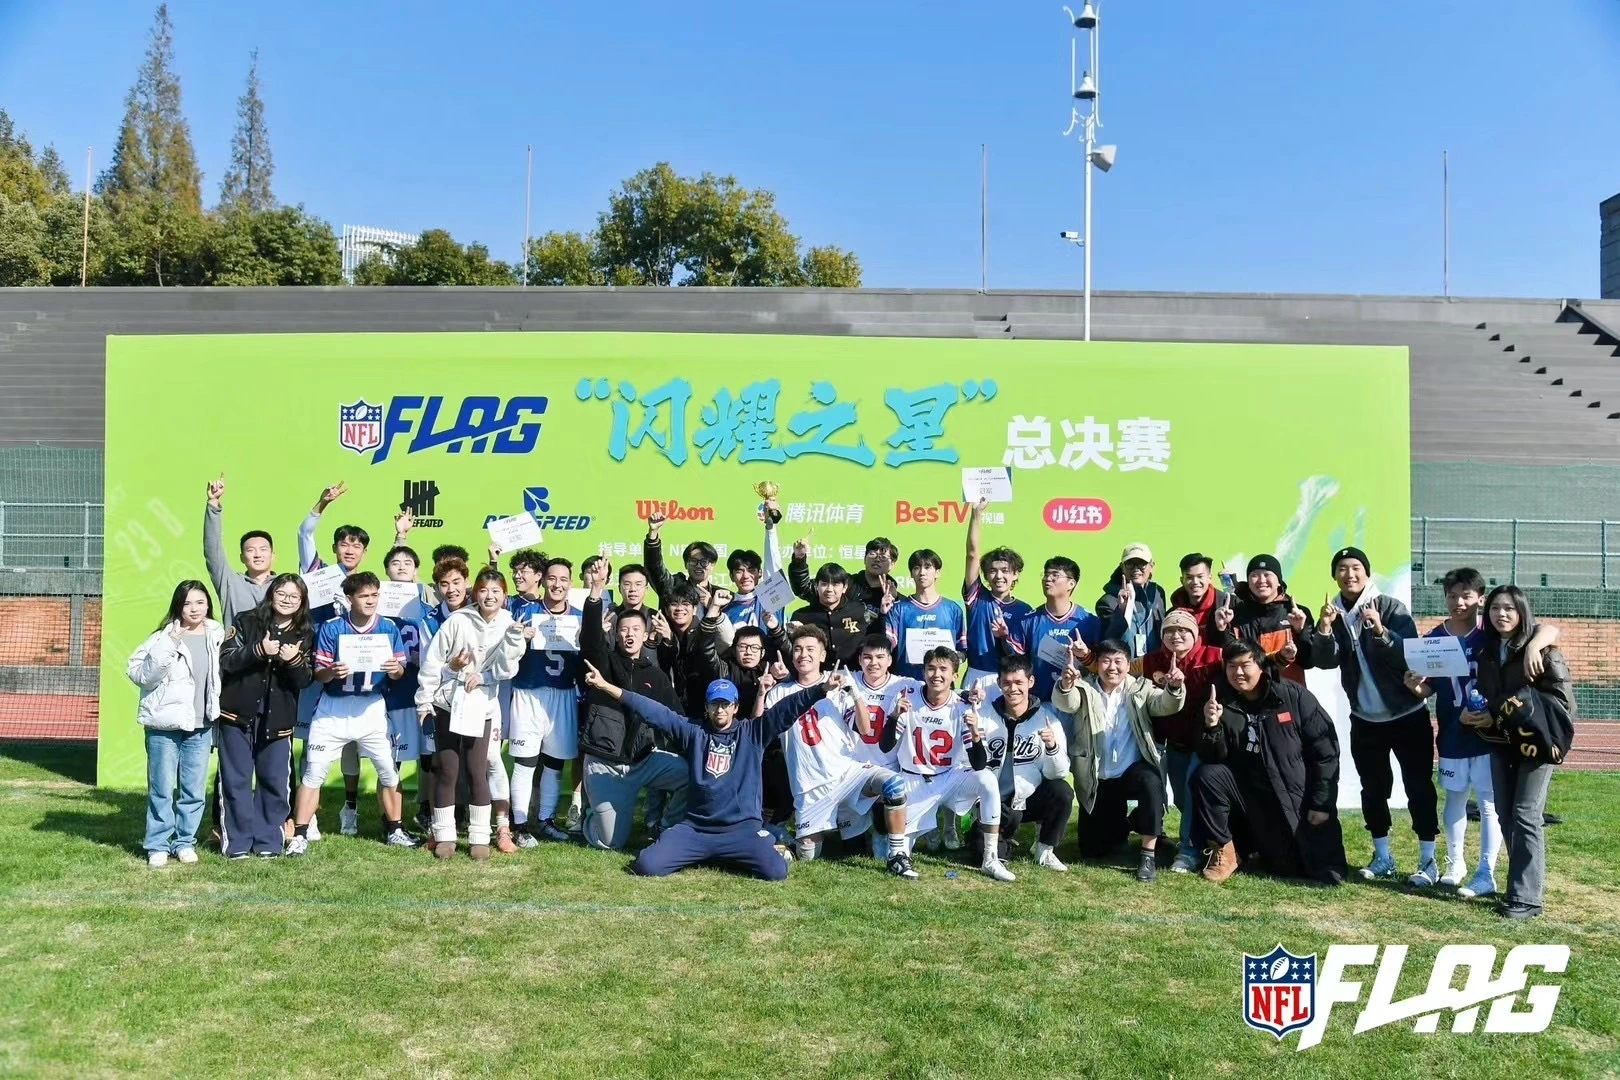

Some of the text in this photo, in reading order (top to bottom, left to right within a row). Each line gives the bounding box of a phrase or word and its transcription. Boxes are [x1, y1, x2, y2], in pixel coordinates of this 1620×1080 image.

[344, 396, 549, 465] NFL FLAG
[1002, 415, 1172, 474] 总决赛
[636, 500, 714, 521] Wilson
[784, 502, 865, 525] 腾讯体育
[896, 501, 970, 525] BesTV
[1051, 505, 1104, 525] 小红书
[798, 707, 822, 747] 8
[912, 726, 953, 766] 12
